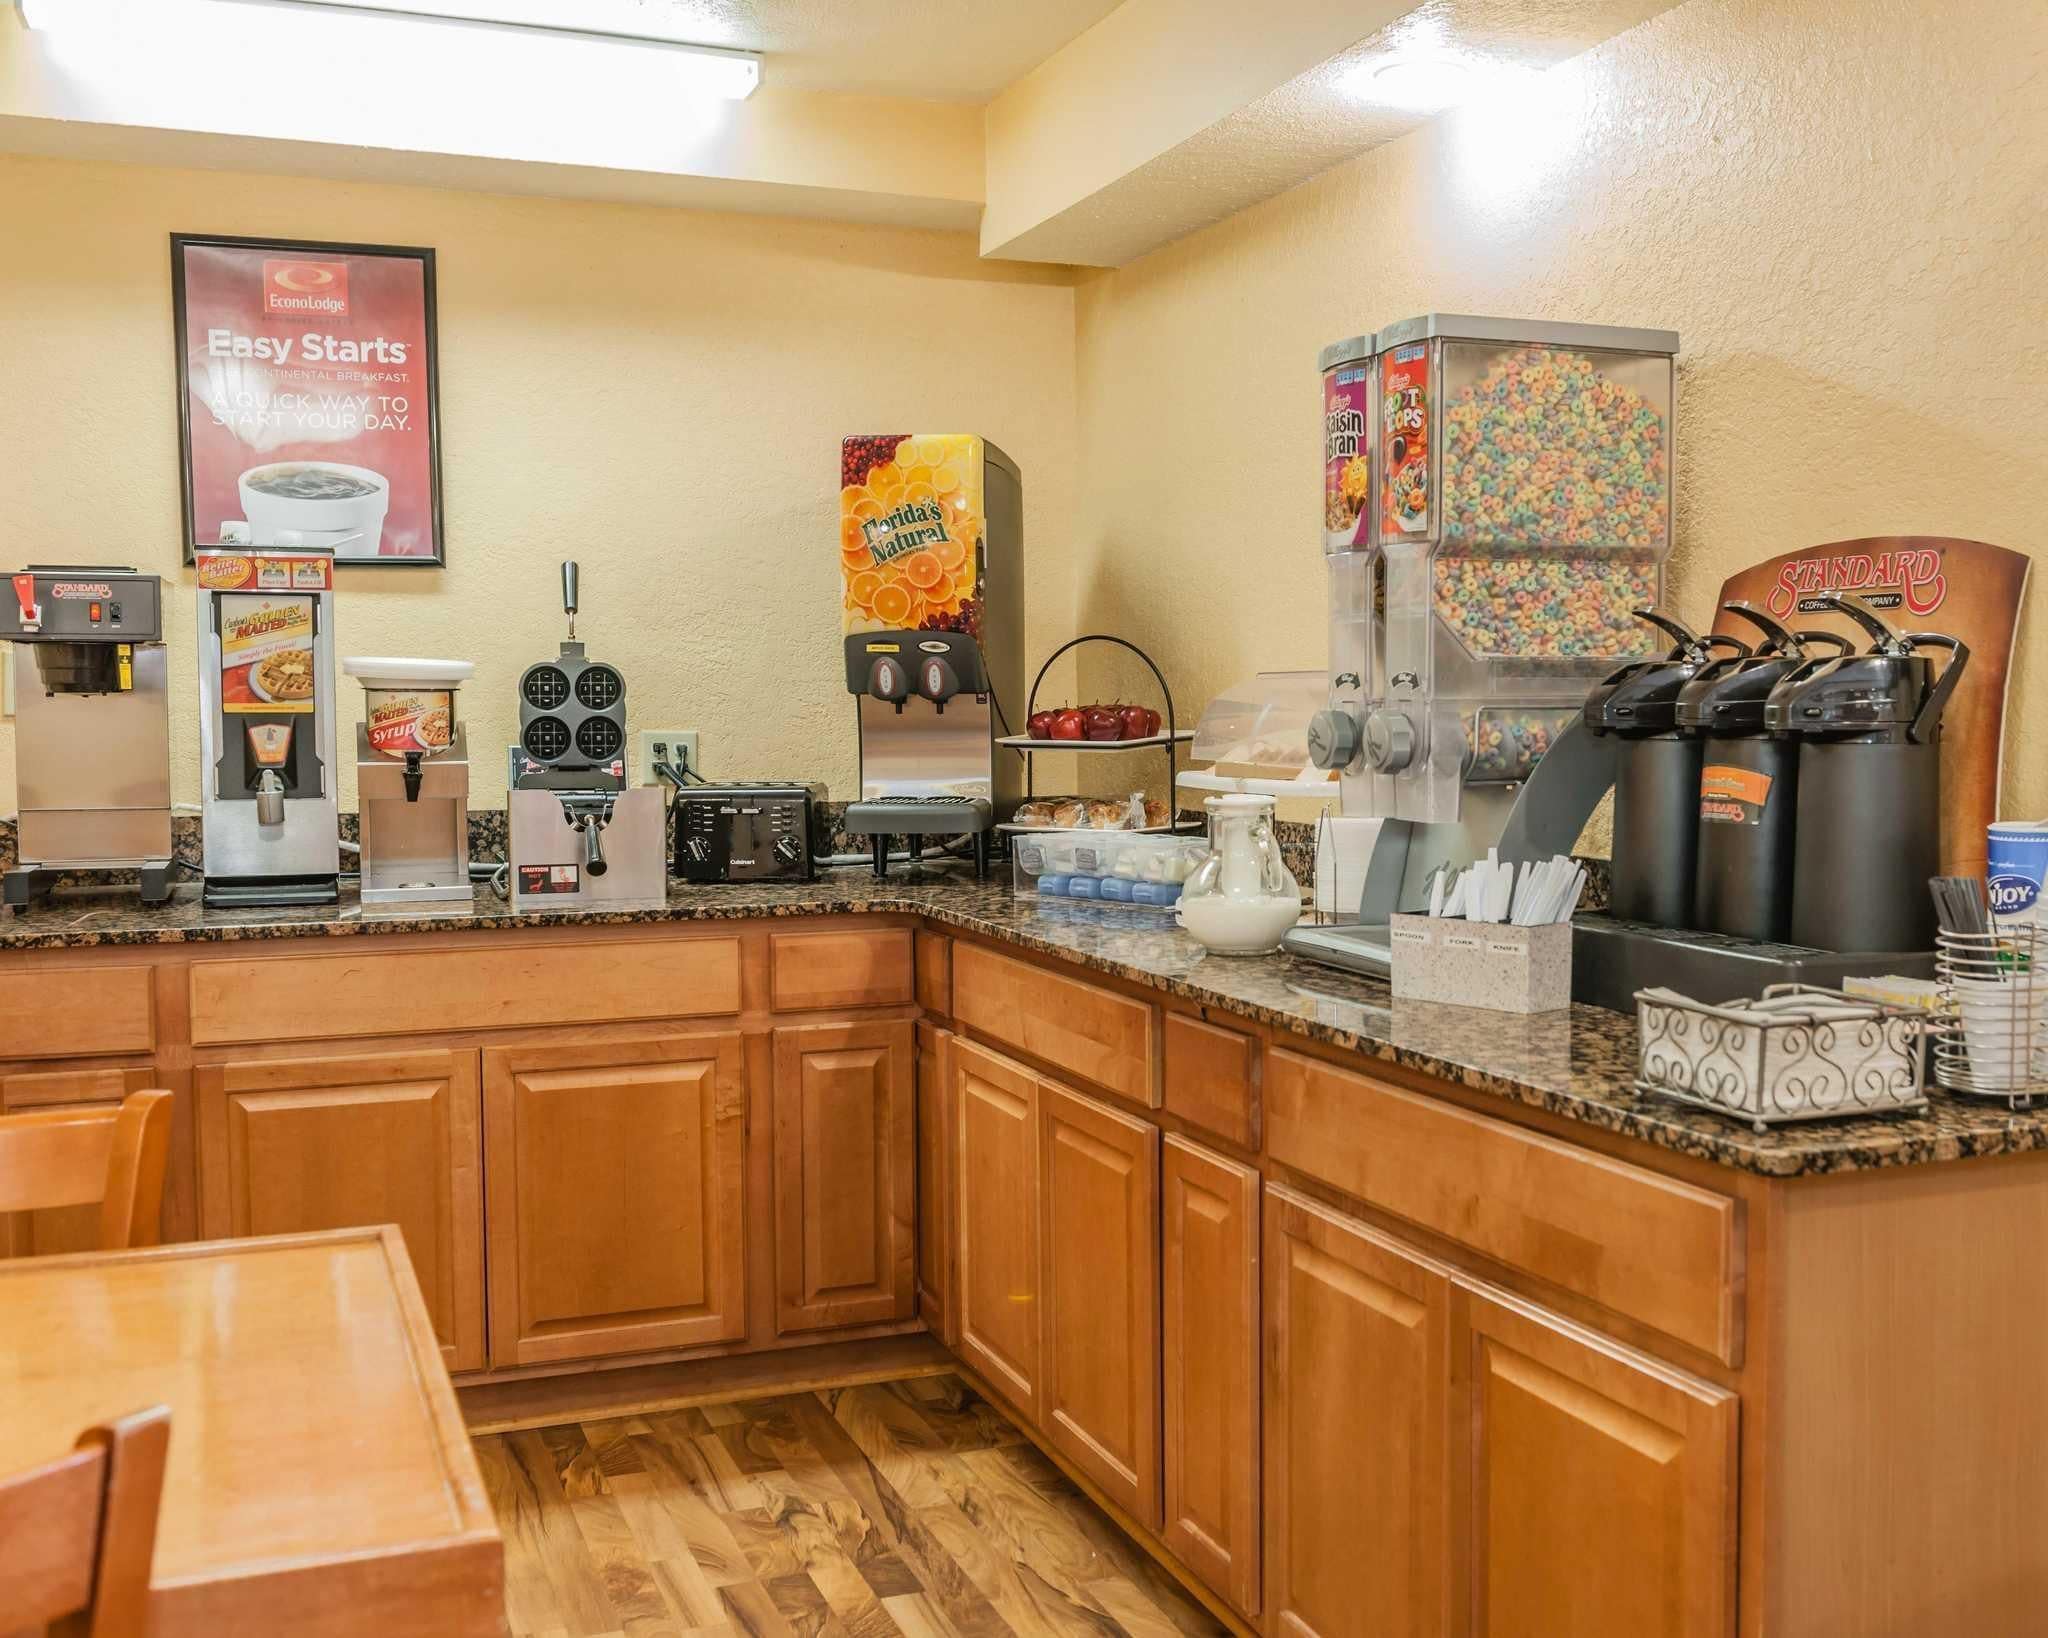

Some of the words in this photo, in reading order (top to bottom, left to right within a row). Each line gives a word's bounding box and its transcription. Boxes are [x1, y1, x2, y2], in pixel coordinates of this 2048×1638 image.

[270, 294, 345, 313] EconoLodge
[208, 328, 293, 366] Easy
[301, 333, 407, 364] Starts
[256, 367, 332, 381] NTINENTAL
[211, 392, 228, 409] A
[236, 392, 312, 411] QUICK
[318, 395, 371, 412] WAY
[378, 396, 409, 413] TO
[212, 411, 285, 426] START
[293, 412, 357, 429] YOUR
[364, 414, 412, 432] DAY.
[870, 522, 950, 567] Natural
[52, 583, 112, 598] STANDARD
[1766, 550, 1946, 620] STANDARD
[236, 618, 288, 639] MALTED
